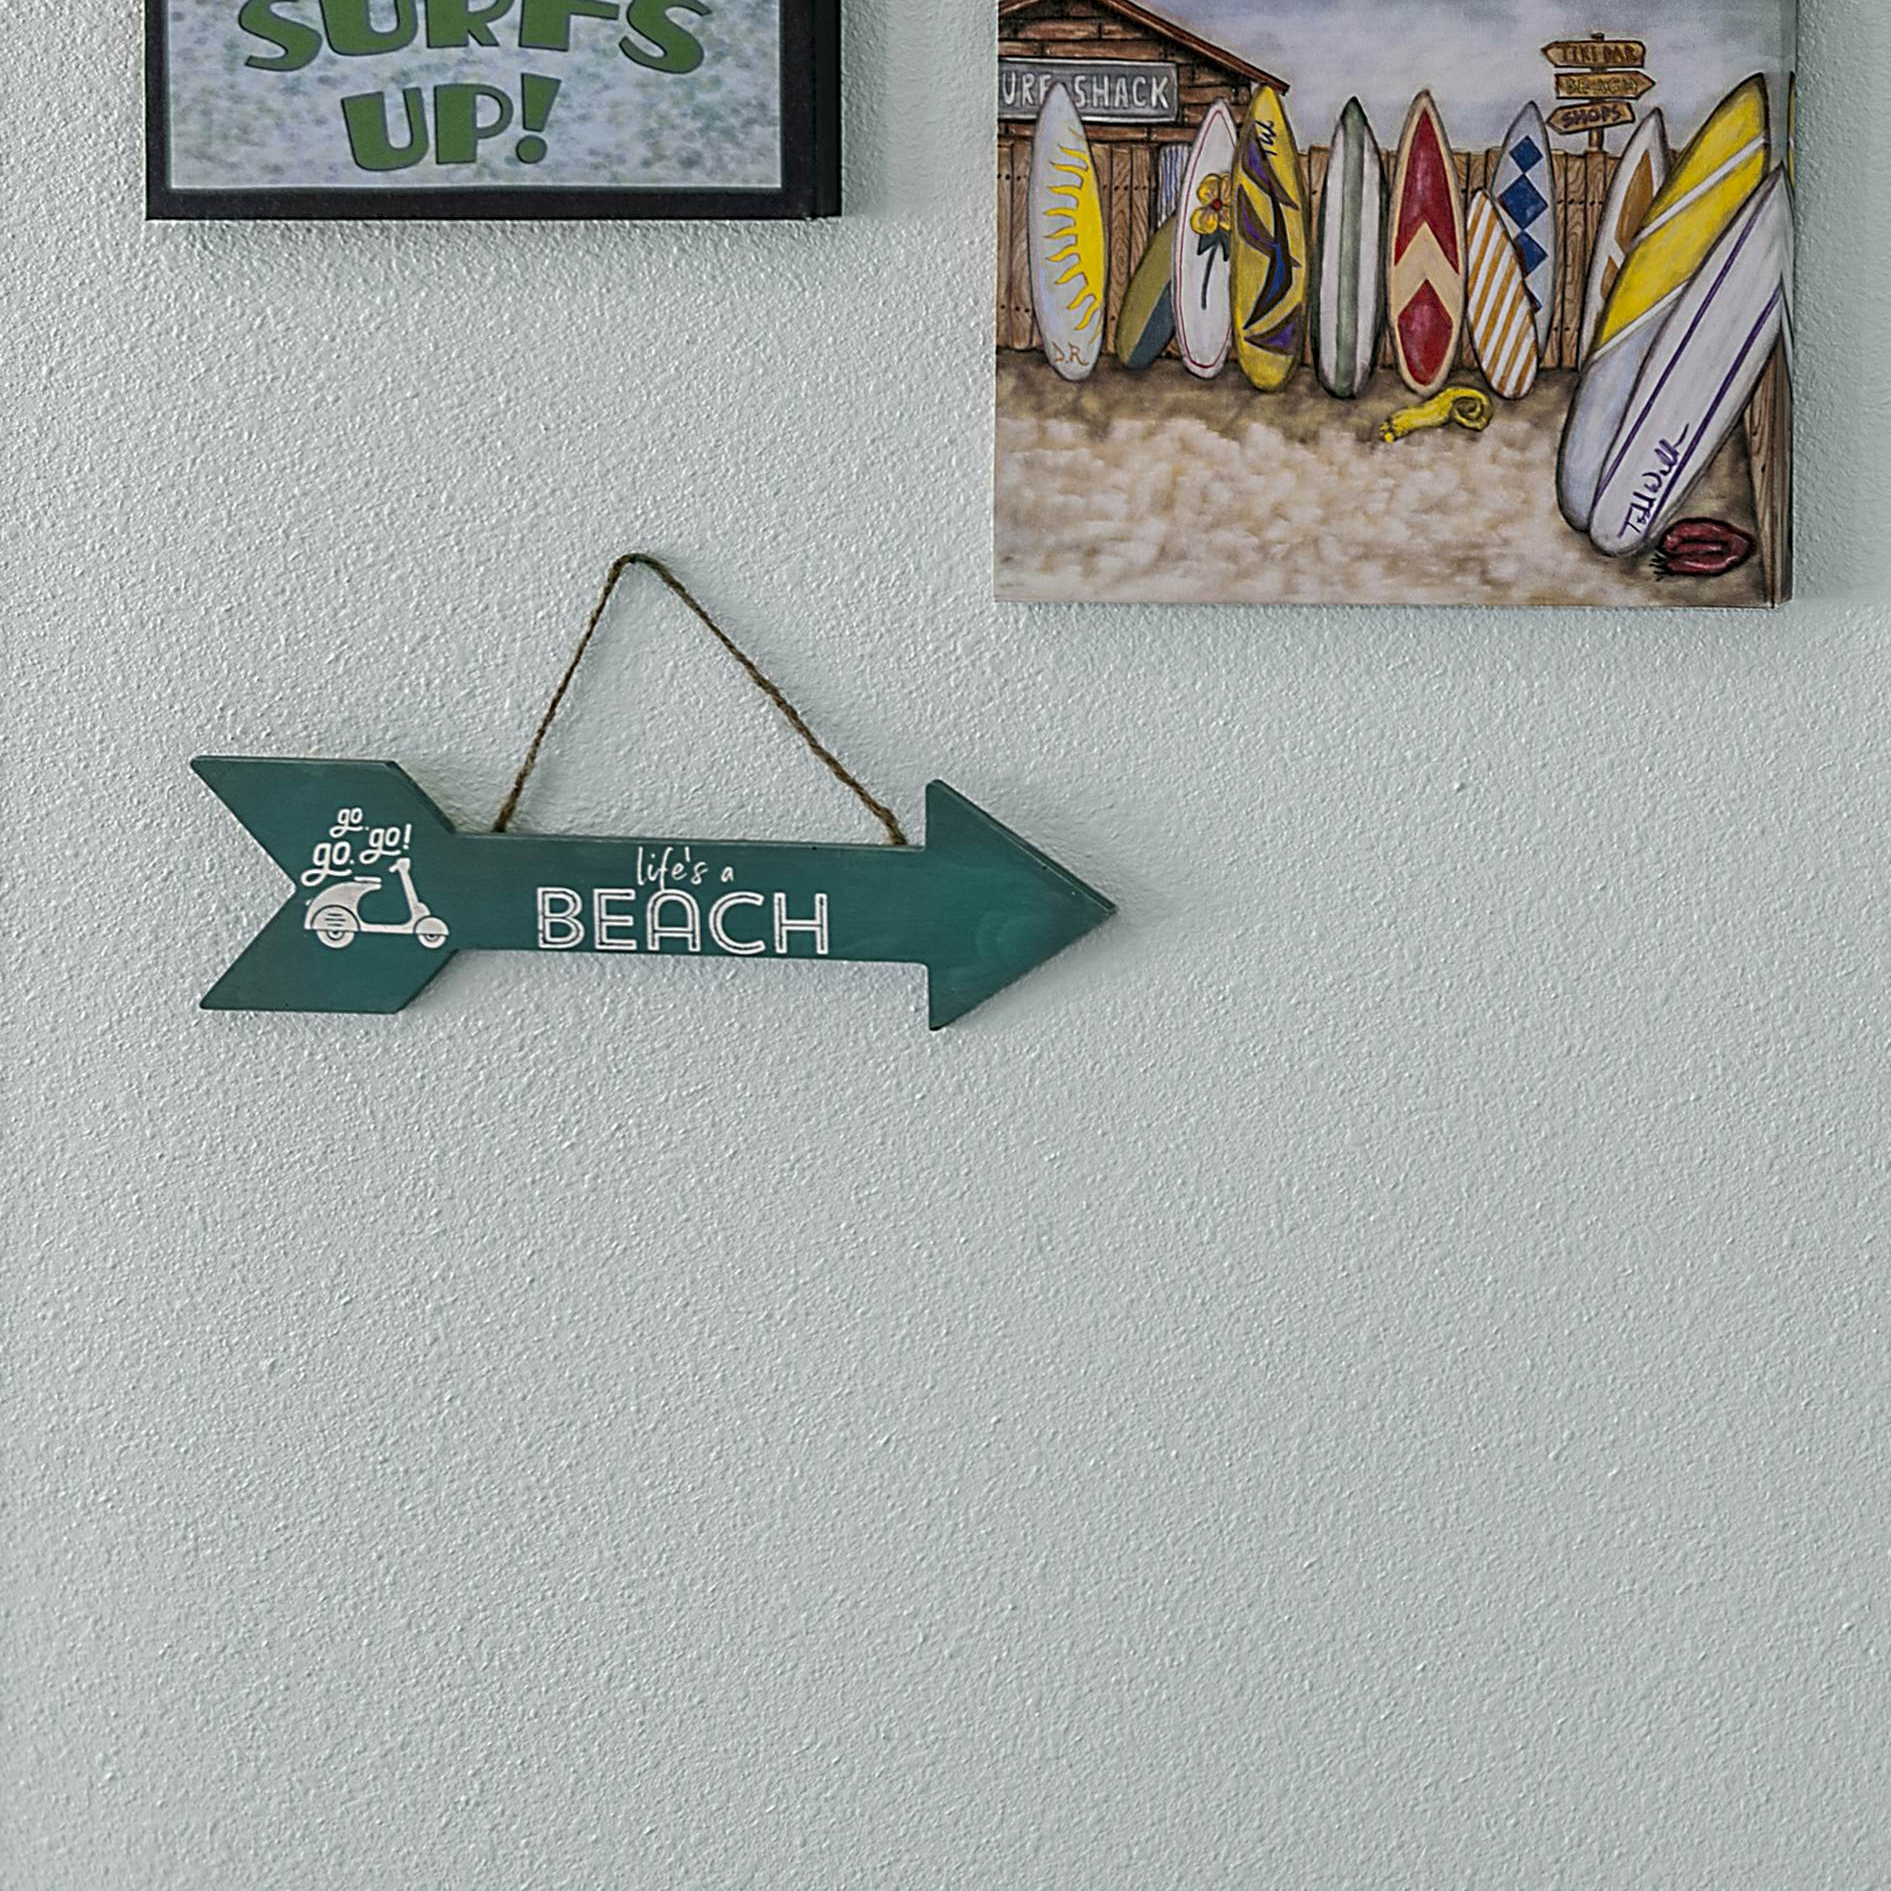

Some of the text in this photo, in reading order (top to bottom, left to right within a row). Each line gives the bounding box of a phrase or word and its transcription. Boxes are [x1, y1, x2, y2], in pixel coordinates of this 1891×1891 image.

[1074, 74, 1169, 110] SHACK
[340, 71, 563, 172] UP!
[359, 823, 412, 864] go!
[636, 846, 735, 891] life's a
[537, 887, 829, 955] BEACH
